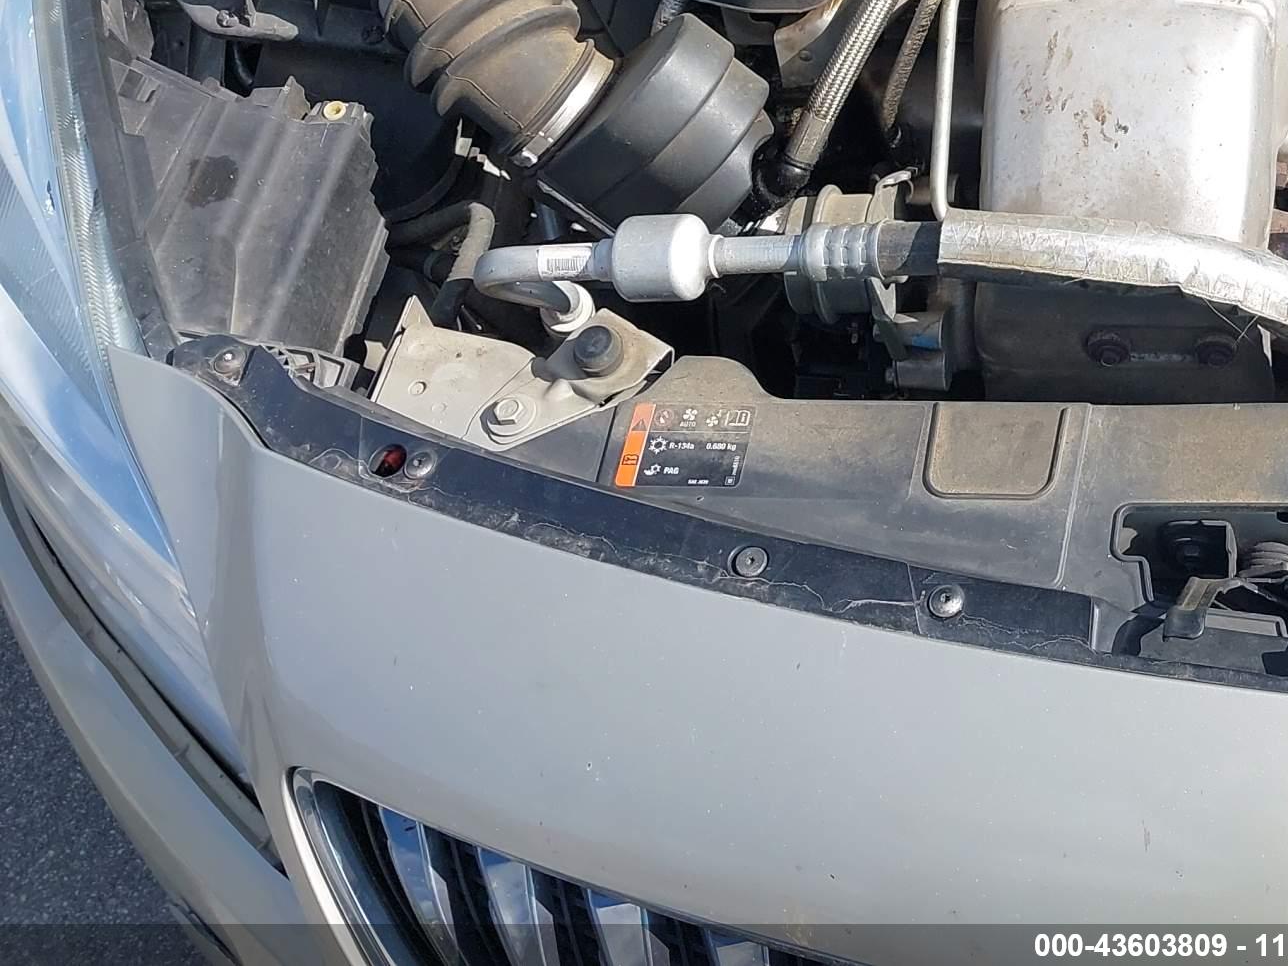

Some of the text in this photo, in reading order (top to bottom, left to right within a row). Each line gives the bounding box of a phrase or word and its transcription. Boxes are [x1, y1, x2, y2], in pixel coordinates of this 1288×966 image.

[669, 441, 695, 450] R-134a
[726, 442, 737, 451] kg
[663, 466, 679, 475] PAG
